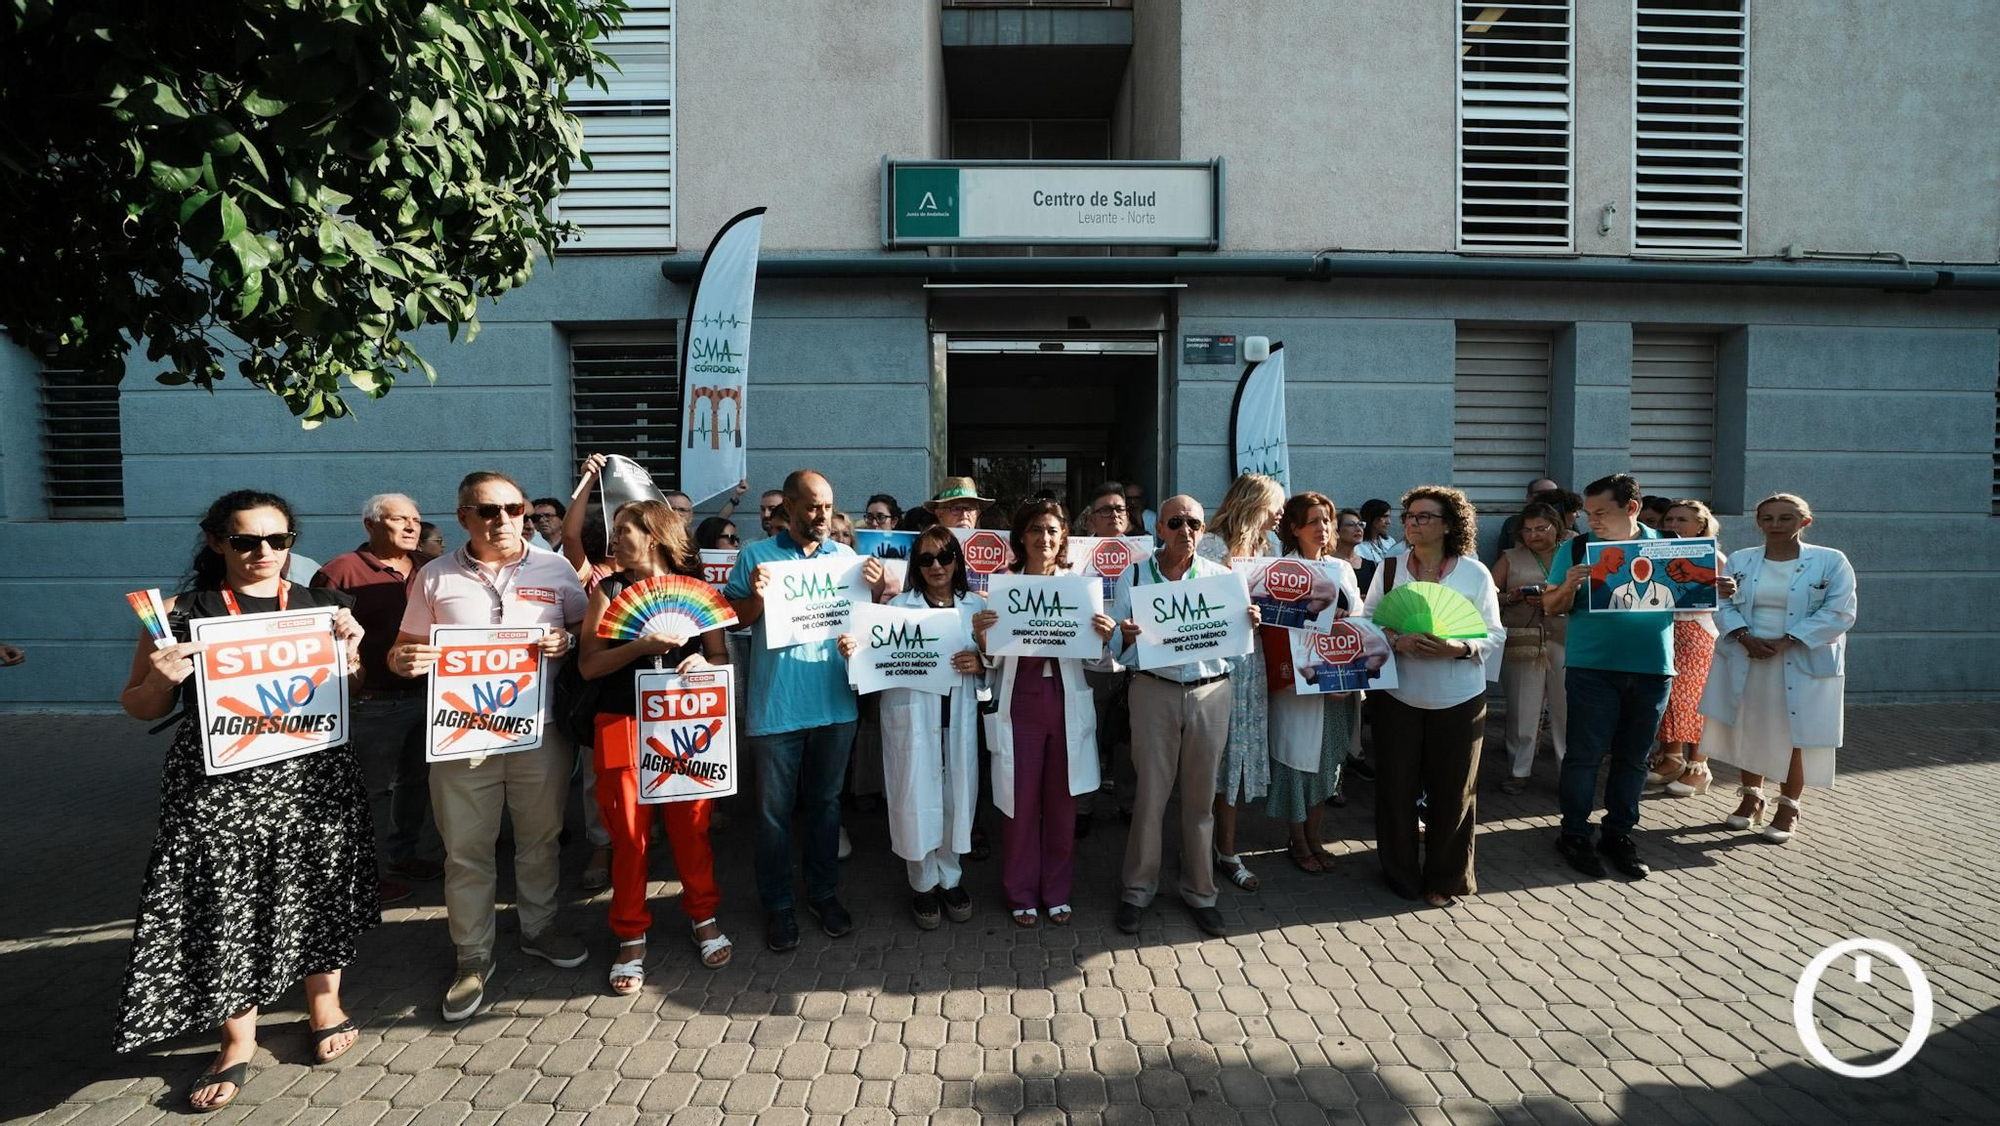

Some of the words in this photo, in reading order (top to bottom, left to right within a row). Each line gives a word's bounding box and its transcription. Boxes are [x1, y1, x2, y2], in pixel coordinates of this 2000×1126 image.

[1033, 190, 1084, 207] Centro
[1090, 191, 1108, 207] de
[1113, 190, 1156, 207] Salud
[1078, 211, 1117, 224] Levante
[1128, 211, 1155, 224] Norte
[692, 336, 742, 363] SMA
[694, 361, 741, 373] CÓRDOBA
[968, 546, 1002, 559] STOP
[1096, 552, 1126, 565] STOP
[703, 566, 731, 582] ST
[1270, 572, 1307, 588] STOP
[783, 572, 849, 602] SMA
[1008, 587, 1078, 618] SMA
[1153, 591, 1226, 623] SMA
[791, 612, 825, 623] SINDICATO
[826, 609, 850, 618] MÉDICO
[811, 619, 842, 628] CÓRDOBA
[871, 621, 939, 649] SMA
[1032, 637, 1066, 645] CÓRDOBA
[1049, 629, 1076, 637] MÉDICO
[1163, 635, 1199, 645] SINDICATO
[1200, 630, 1227, 640] MÉDICO
[1185, 640, 1219, 650] CÓRDOBA
[1319, 635, 1356, 650] STOP
[215, 637, 321, 674] STOP
[445, 647, 529, 673] STOP
[875, 661, 910, 669] SINDICATO
[255, 675, 316, 718] NO
[472, 679, 519, 715] NO
[647, 692, 718, 718] STOP
[209, 713, 338, 736] AGRESIONES
[433, 709, 534, 735] AGRESIONES
[671, 724, 711, 759] NO
[641, 753, 728, 780] AGRESIONES
